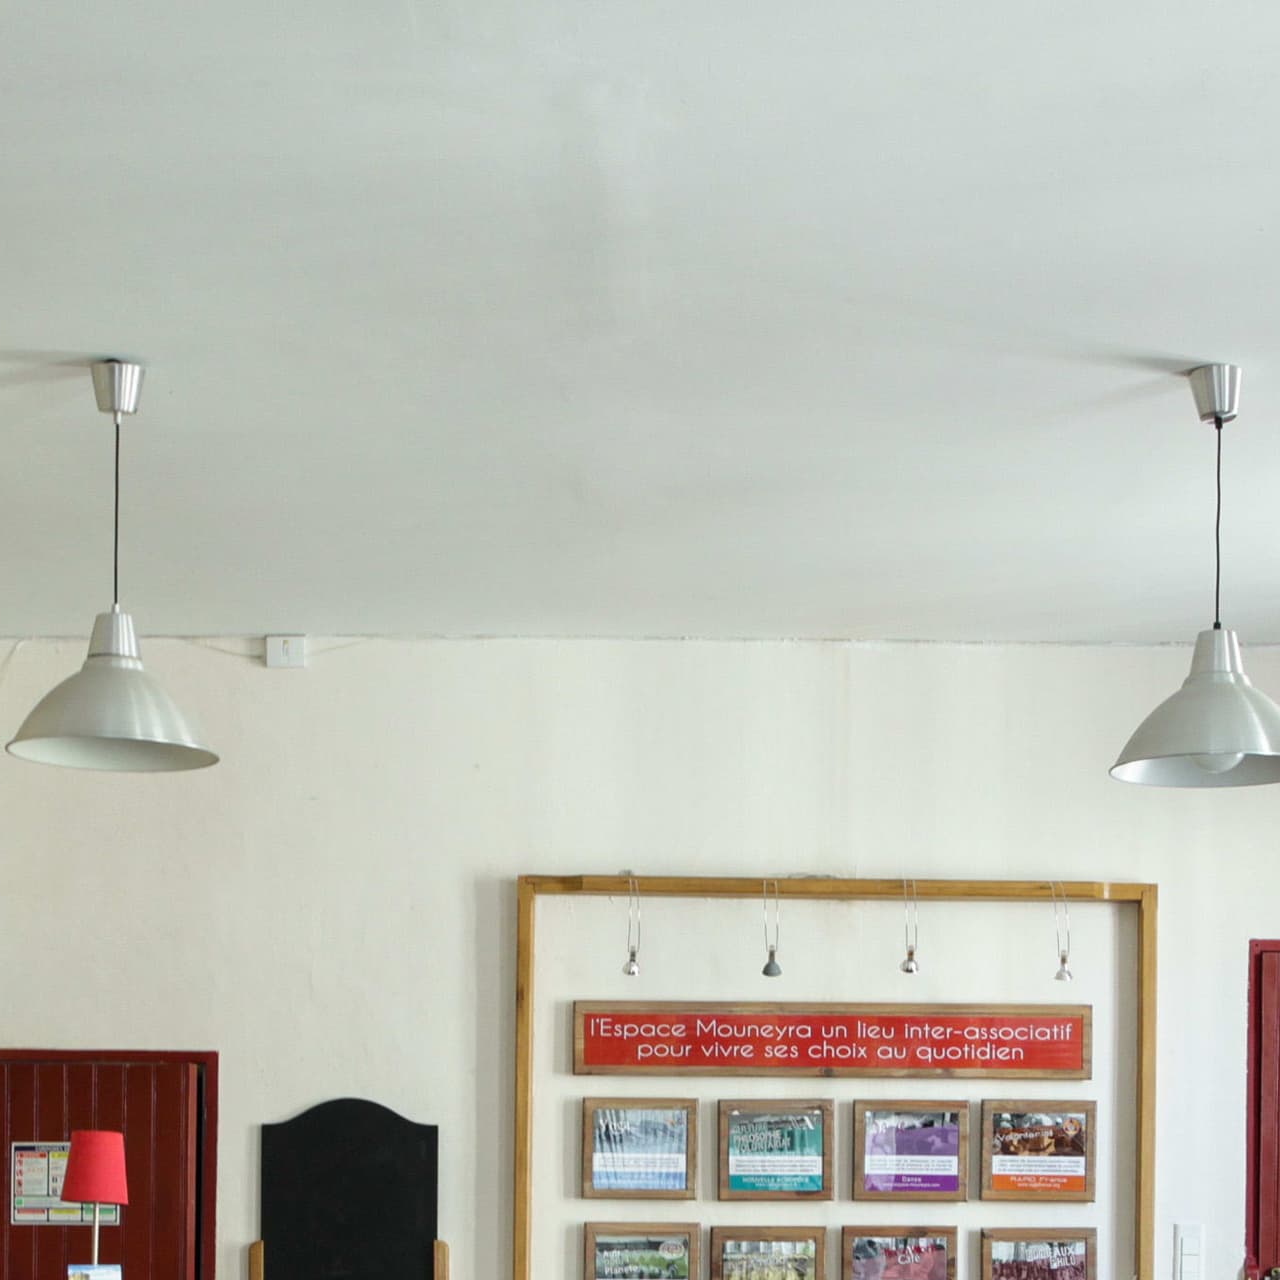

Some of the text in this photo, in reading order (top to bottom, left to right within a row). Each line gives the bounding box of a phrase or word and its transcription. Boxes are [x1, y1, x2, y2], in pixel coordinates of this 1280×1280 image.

[590, 1017, 1073, 1042] l'Espace Mouneyra un lieu inter-associatif
[636, 1041, 1025, 1063] pour vivre ses choix au quotidien
